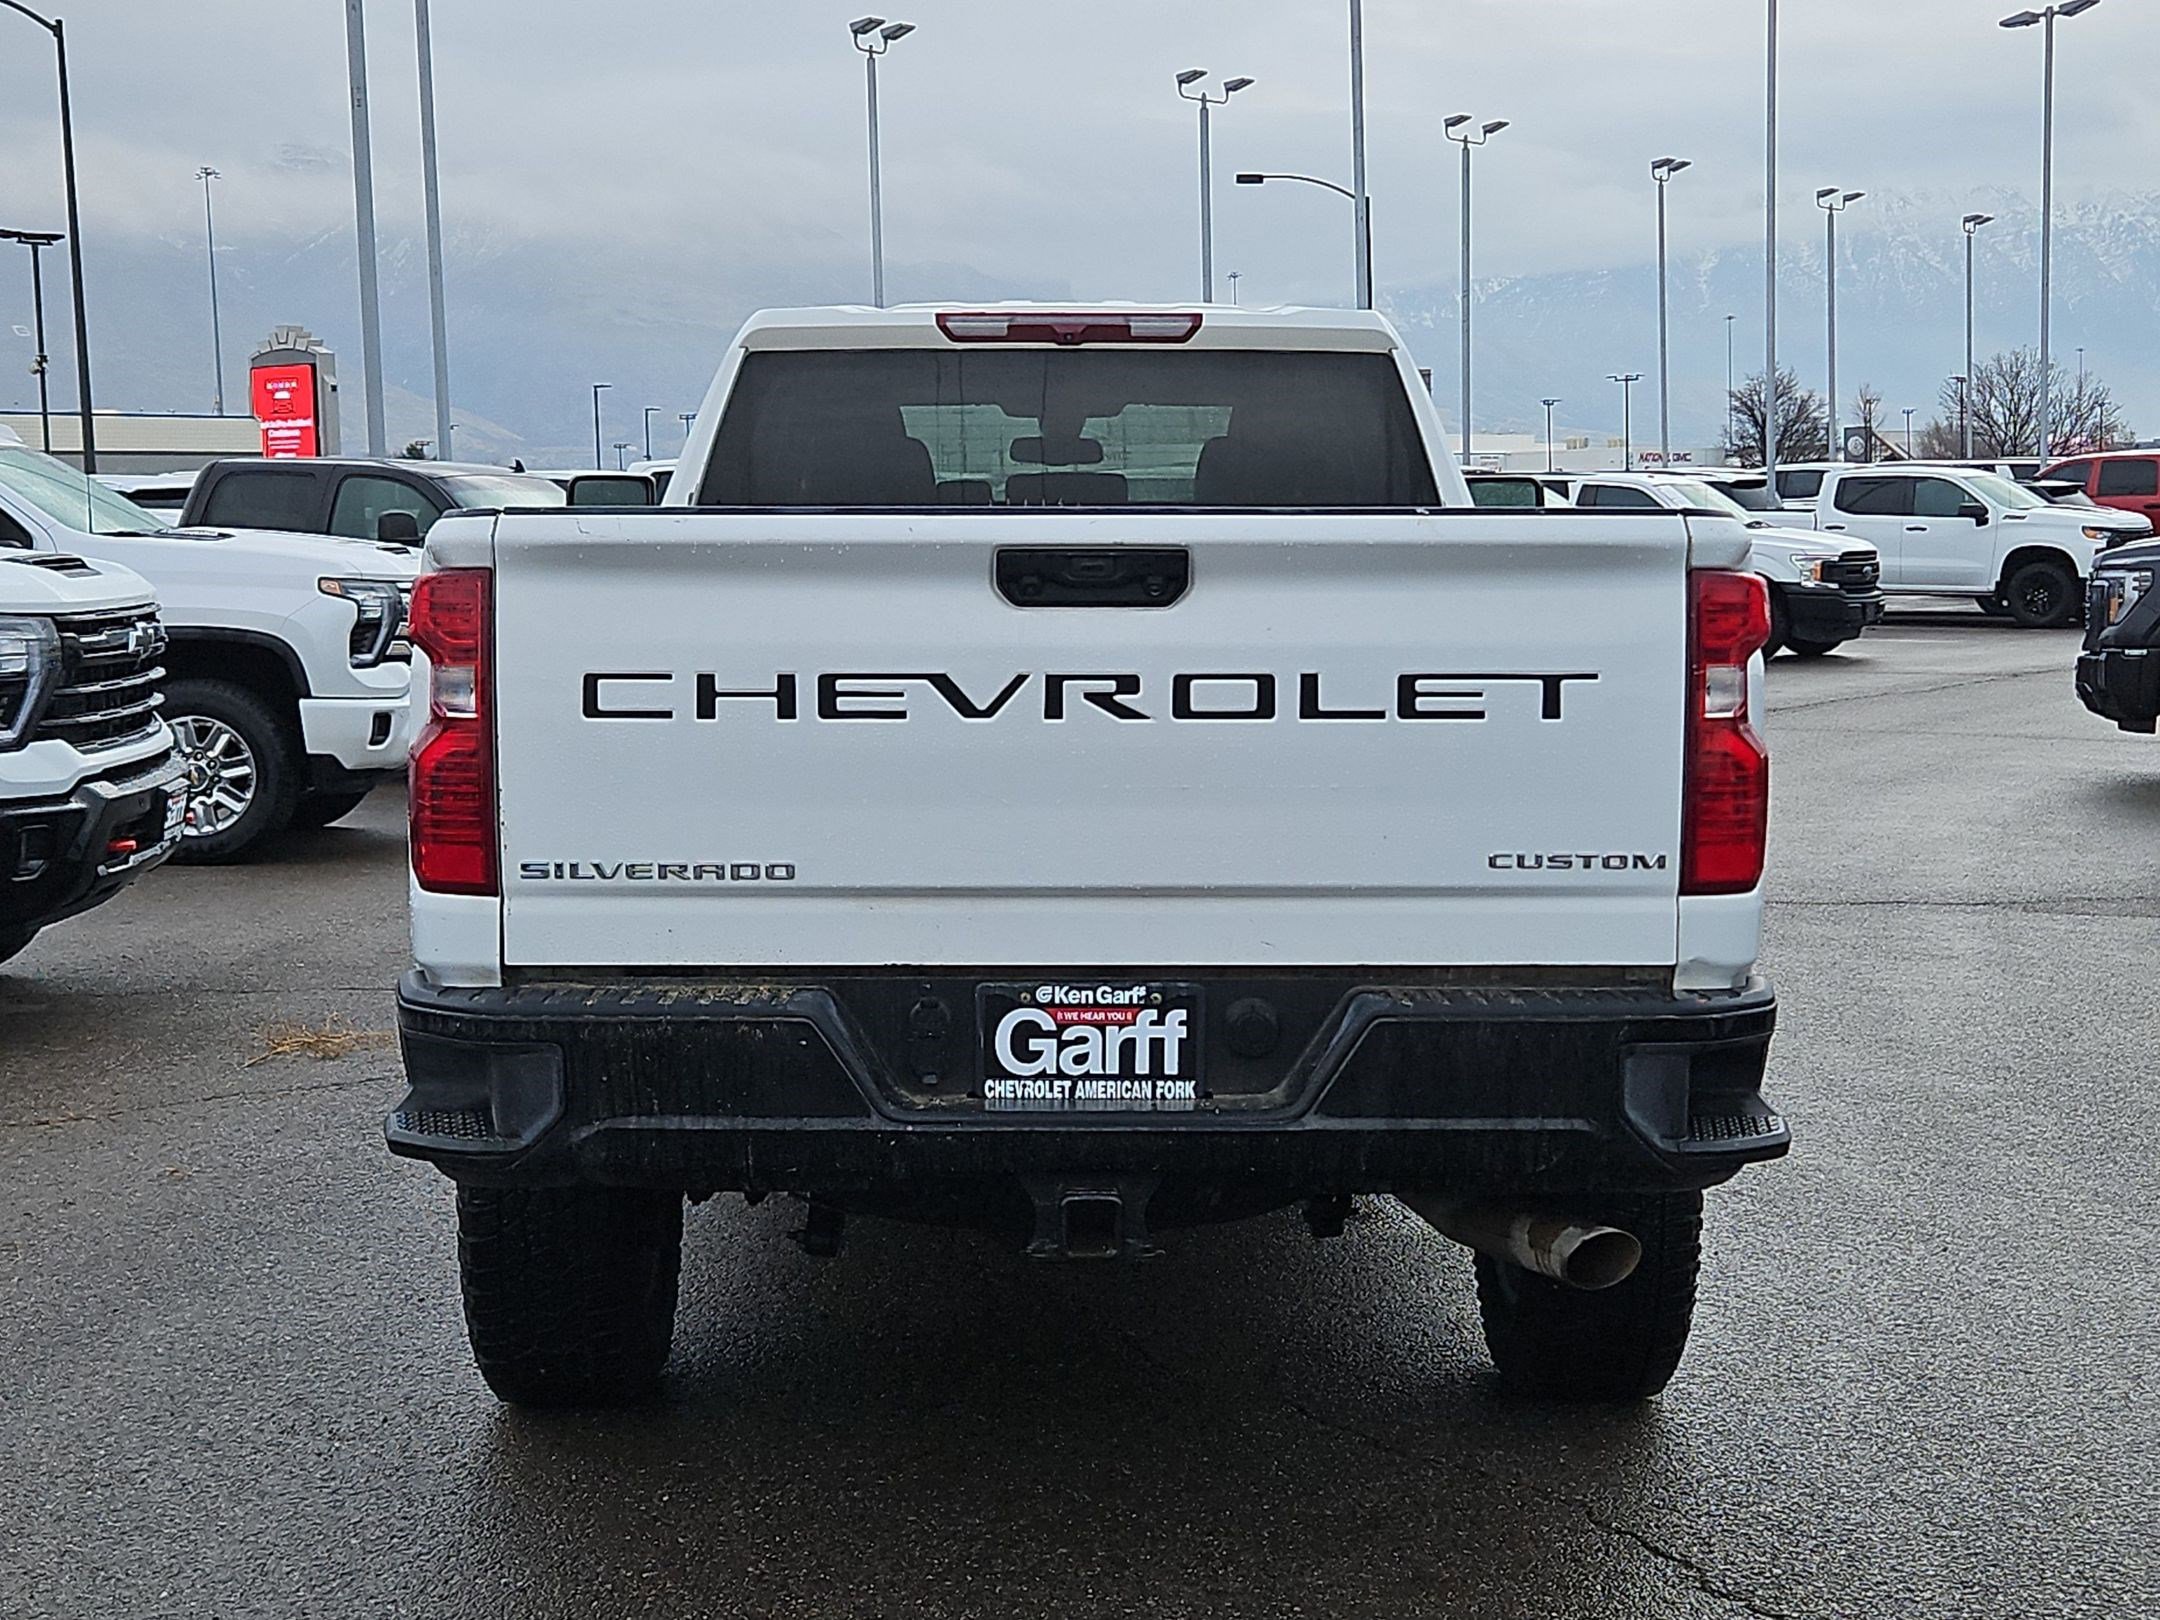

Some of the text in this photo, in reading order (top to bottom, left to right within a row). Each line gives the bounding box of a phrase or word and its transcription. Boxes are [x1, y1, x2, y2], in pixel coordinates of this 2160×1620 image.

[582, 672, 1599, 720] CHEVROLET
[519, 861, 796, 881] SILVERADO
[1487, 853, 1667, 870] CUSTOM
[1054, 985, 1147, 1005] Ken Garff
[1064, 1011, 1126, 1021] WE HEAR YOU
[995, 1007, 1188, 1077] Garff
[984, 1078, 1197, 1100] CHEVROLET AMERICAN FORK
